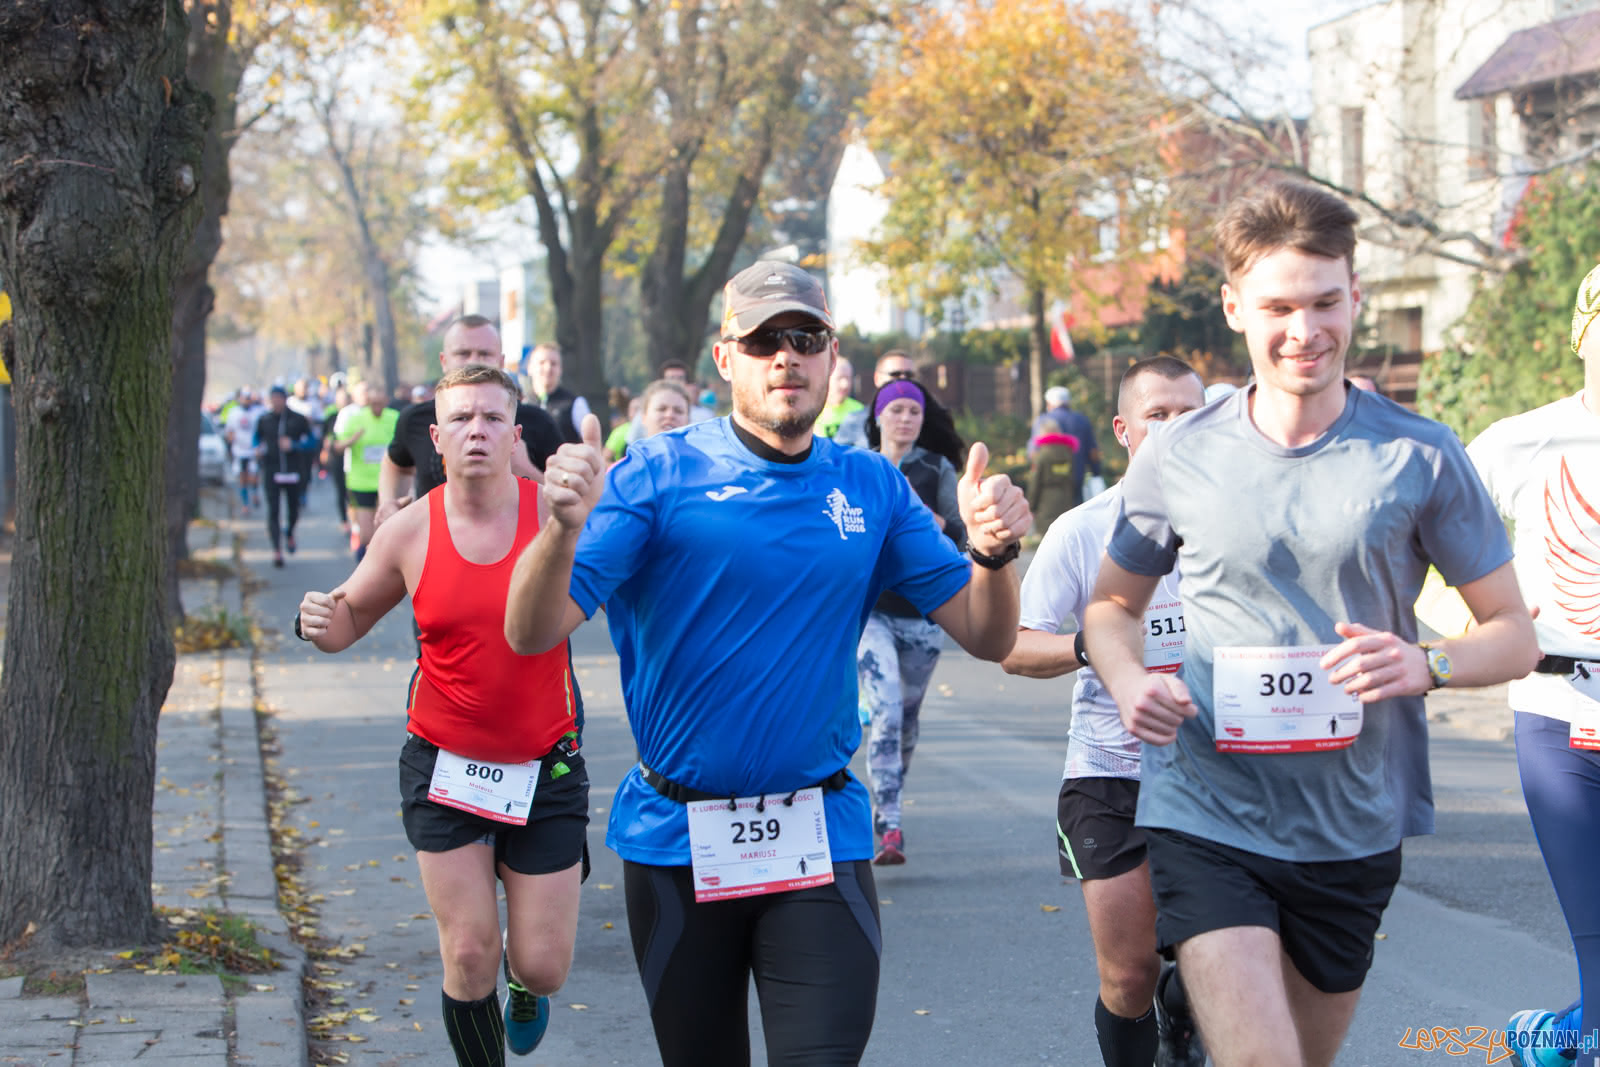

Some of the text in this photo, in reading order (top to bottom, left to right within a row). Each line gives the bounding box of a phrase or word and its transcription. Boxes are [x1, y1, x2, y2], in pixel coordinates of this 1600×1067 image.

[843, 516, 865, 524] RUN
[1151, 616, 1186, 636] 511
[1260, 672, 1313, 696] 302
[466, 763, 504, 783] 800
[731, 818, 780, 844] 259
[815, 817, 823, 843] STREFA
[740, 849, 777, 860] MARIUSZ
